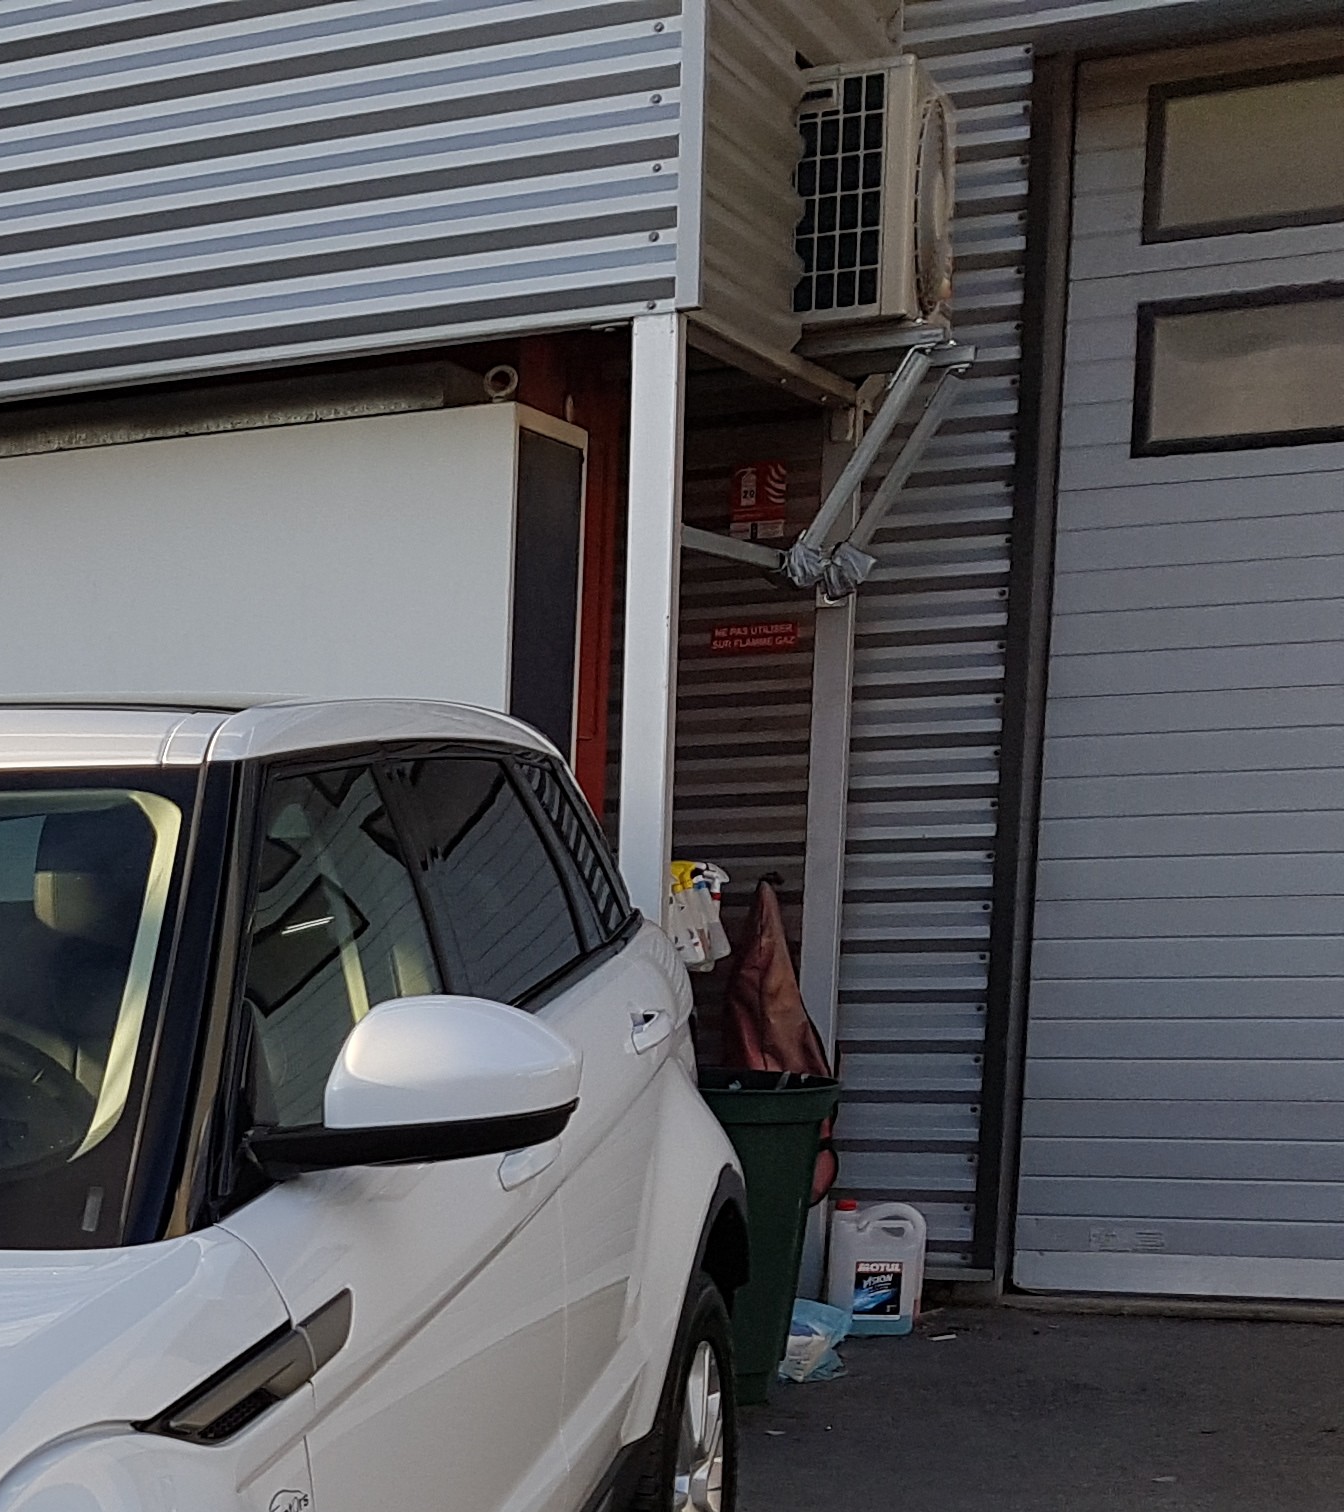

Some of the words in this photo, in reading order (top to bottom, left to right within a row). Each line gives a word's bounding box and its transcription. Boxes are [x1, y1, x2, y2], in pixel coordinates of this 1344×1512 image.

[729, 626, 748, 636] PAS
[750, 623, 793, 635] UTILISER
[711, 638, 732, 650] SUR
[775, 635, 796, 645] GAZ
[857, 1262, 901, 1272] MOTUL
